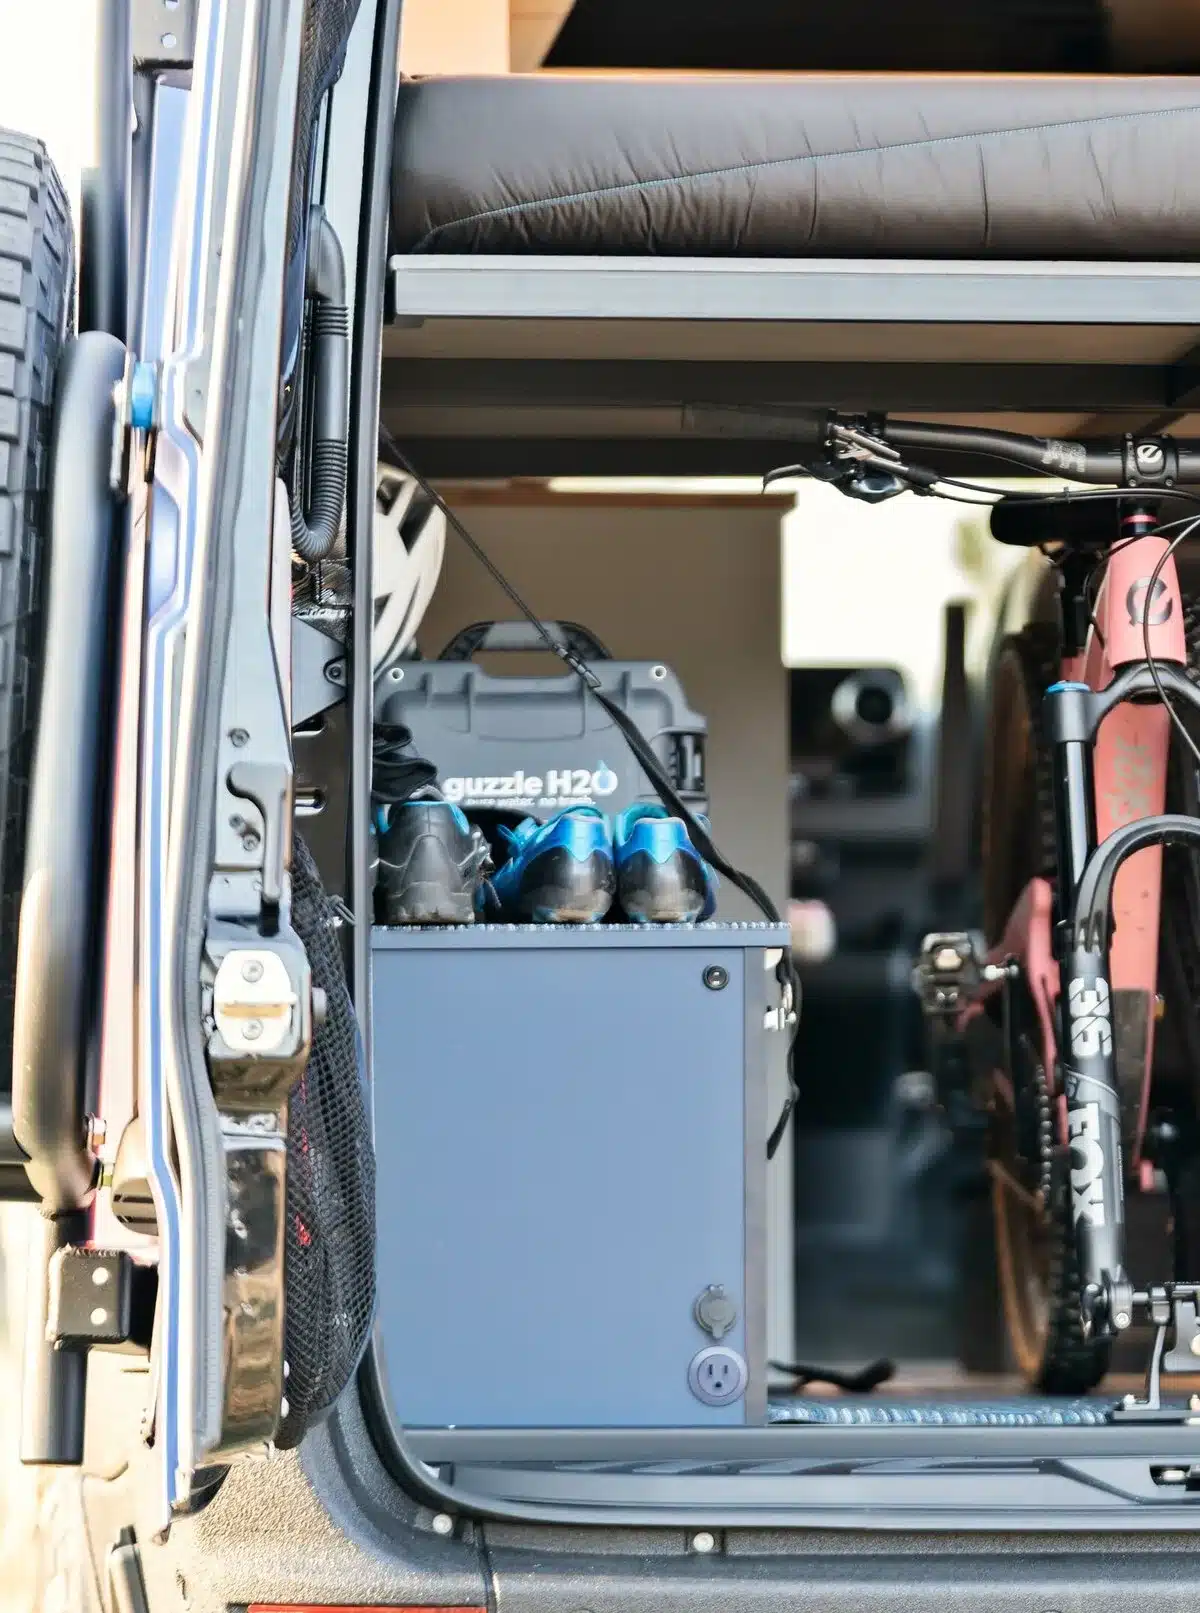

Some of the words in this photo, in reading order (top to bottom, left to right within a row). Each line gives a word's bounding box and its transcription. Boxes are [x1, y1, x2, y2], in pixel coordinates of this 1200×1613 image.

[441, 769, 543, 802] guzzle
[547, 768, 618, 796] H2O
[1068, 977, 1113, 1057] 36
[1067, 1103, 1105, 1226] FOX
